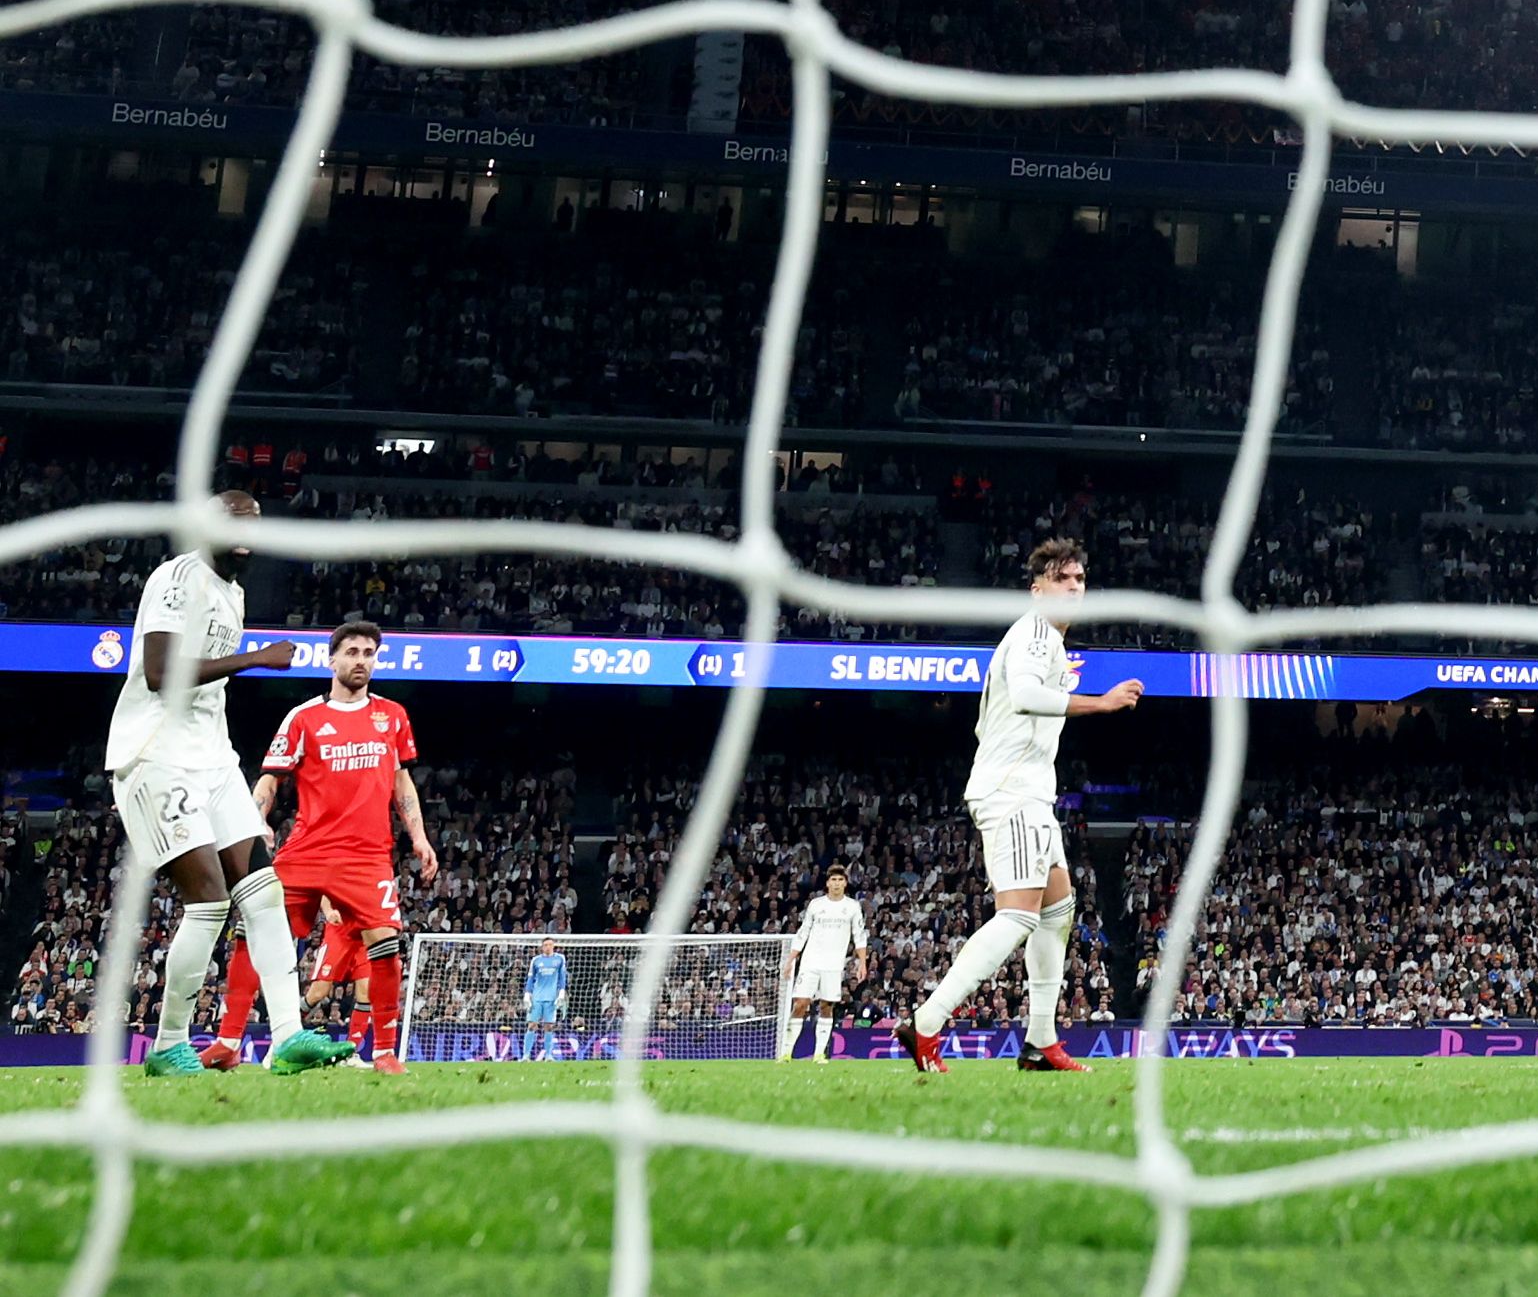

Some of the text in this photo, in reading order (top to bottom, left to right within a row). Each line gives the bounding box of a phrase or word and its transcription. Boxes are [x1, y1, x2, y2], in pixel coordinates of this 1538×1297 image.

[112, 103, 228, 130] Bernabéu
[426, 122, 535, 148] Bernabéu
[1010, 158, 1112, 182] Bernabéu
[402, 645, 423, 670] F.
[465, 646, 482, 671] 1
[491, 650, 517, 672] (2)
[571, 648, 651, 674] 59:20
[697, 653, 722, 676] (1)
[730, 653, 746, 677] 1
[830, 654, 863, 680] SL
[867, 655, 981, 683] BENFICA
[1436, 664, 1487, 682] UEFA
[320, 740, 388, 760] Emirates
[331, 755, 380, 772] FLY BETTER
[156, 786, 198, 824] 22
[1029, 825, 1052, 856] 17
